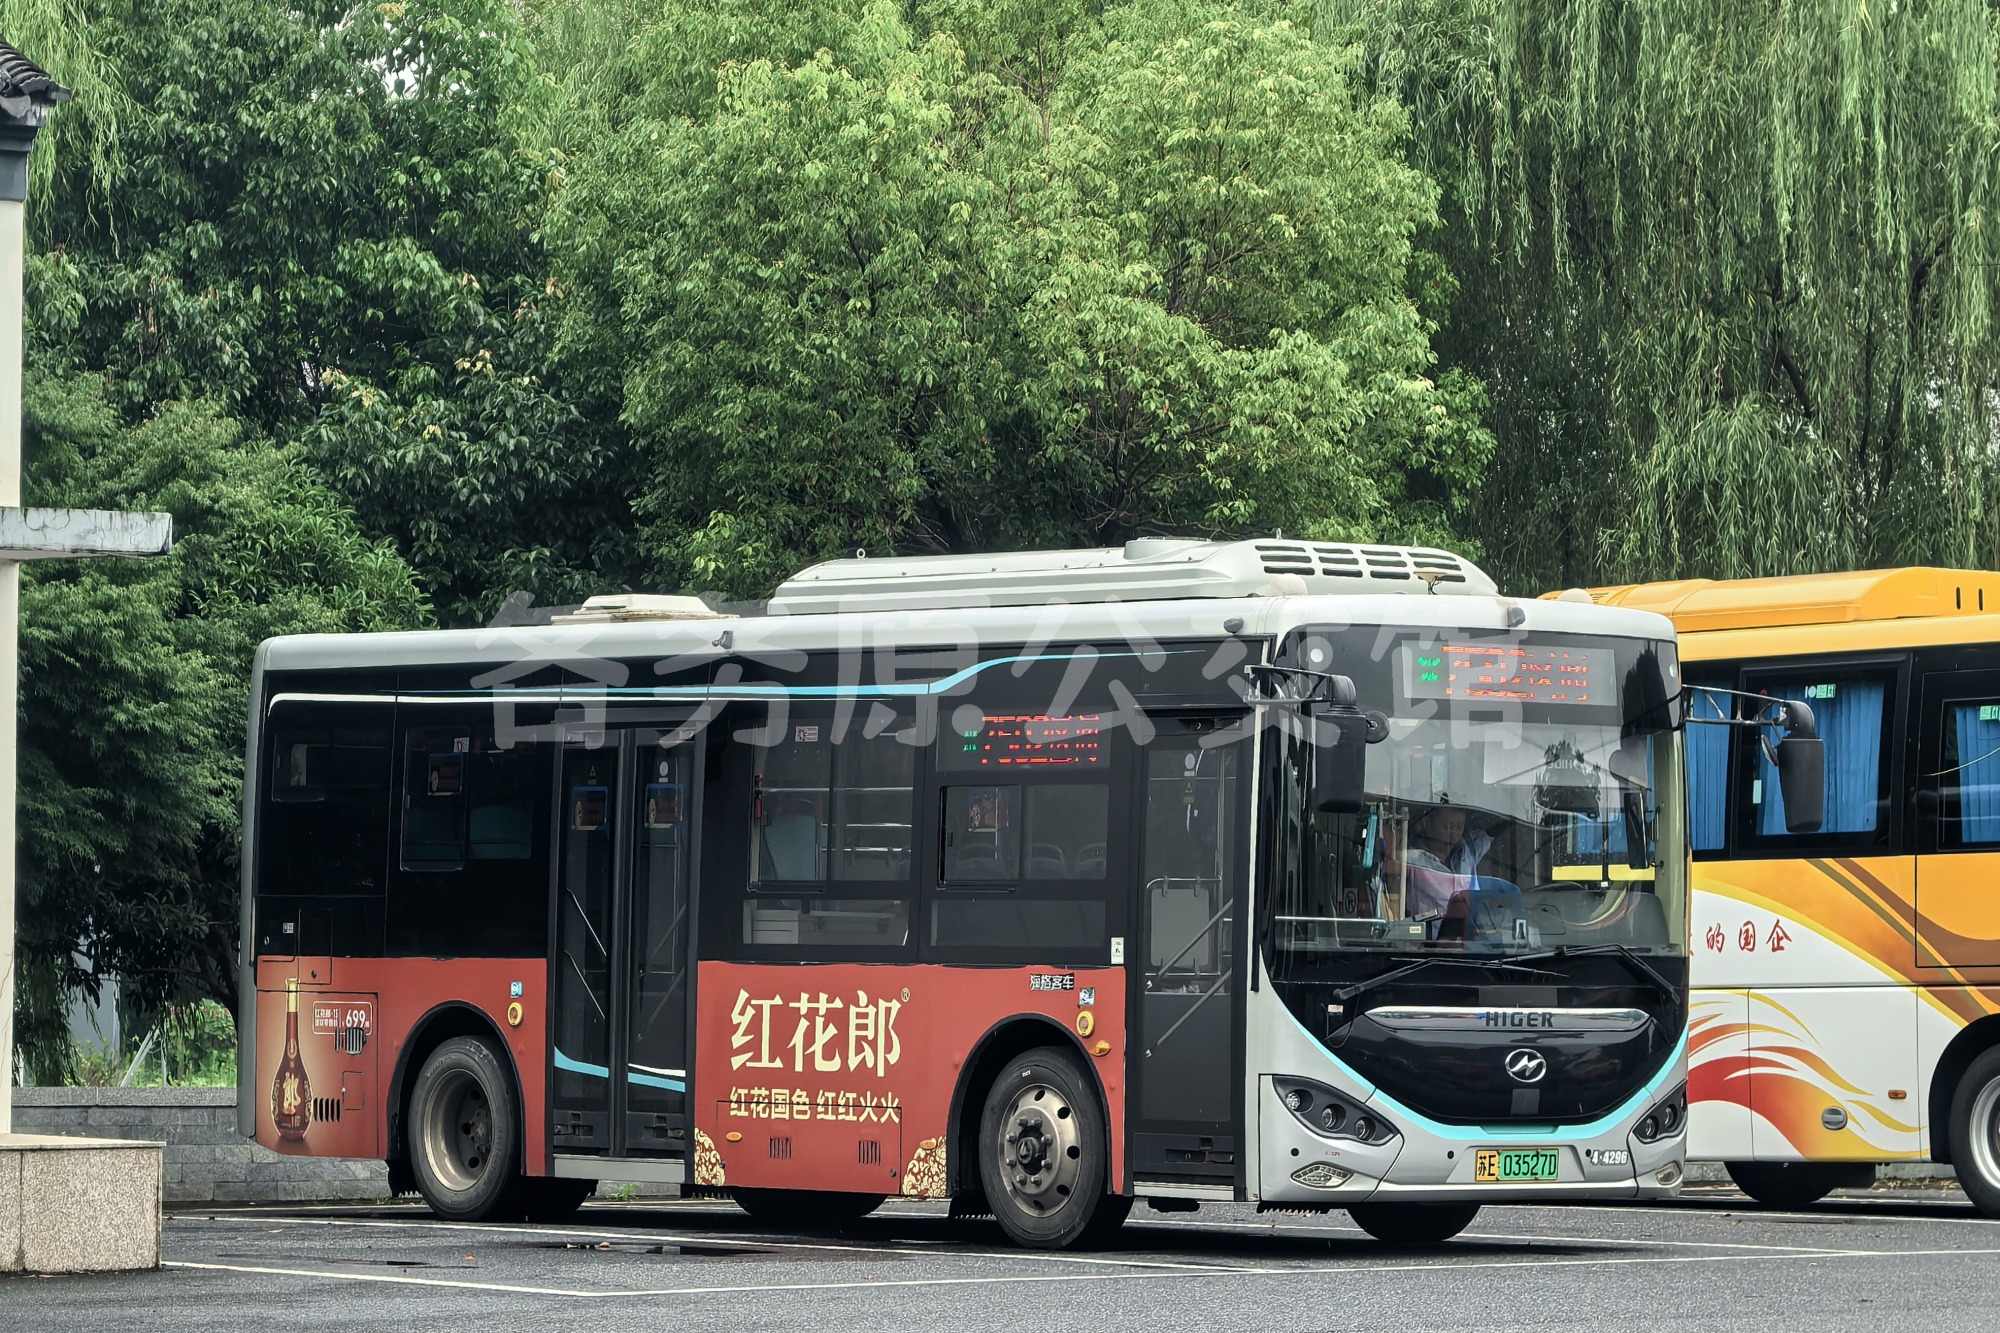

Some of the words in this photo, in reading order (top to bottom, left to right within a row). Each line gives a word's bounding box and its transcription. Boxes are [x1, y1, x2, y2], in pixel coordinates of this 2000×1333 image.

[1690, 919, 1793, 956] 的国企
[1029, 974, 1074, 990] 海格客车
[1485, 1011, 1554, 1028] HIGER
[730, 1086, 811, 1120] 红花国色
[816, 1089, 900, 1124] 红红火火
